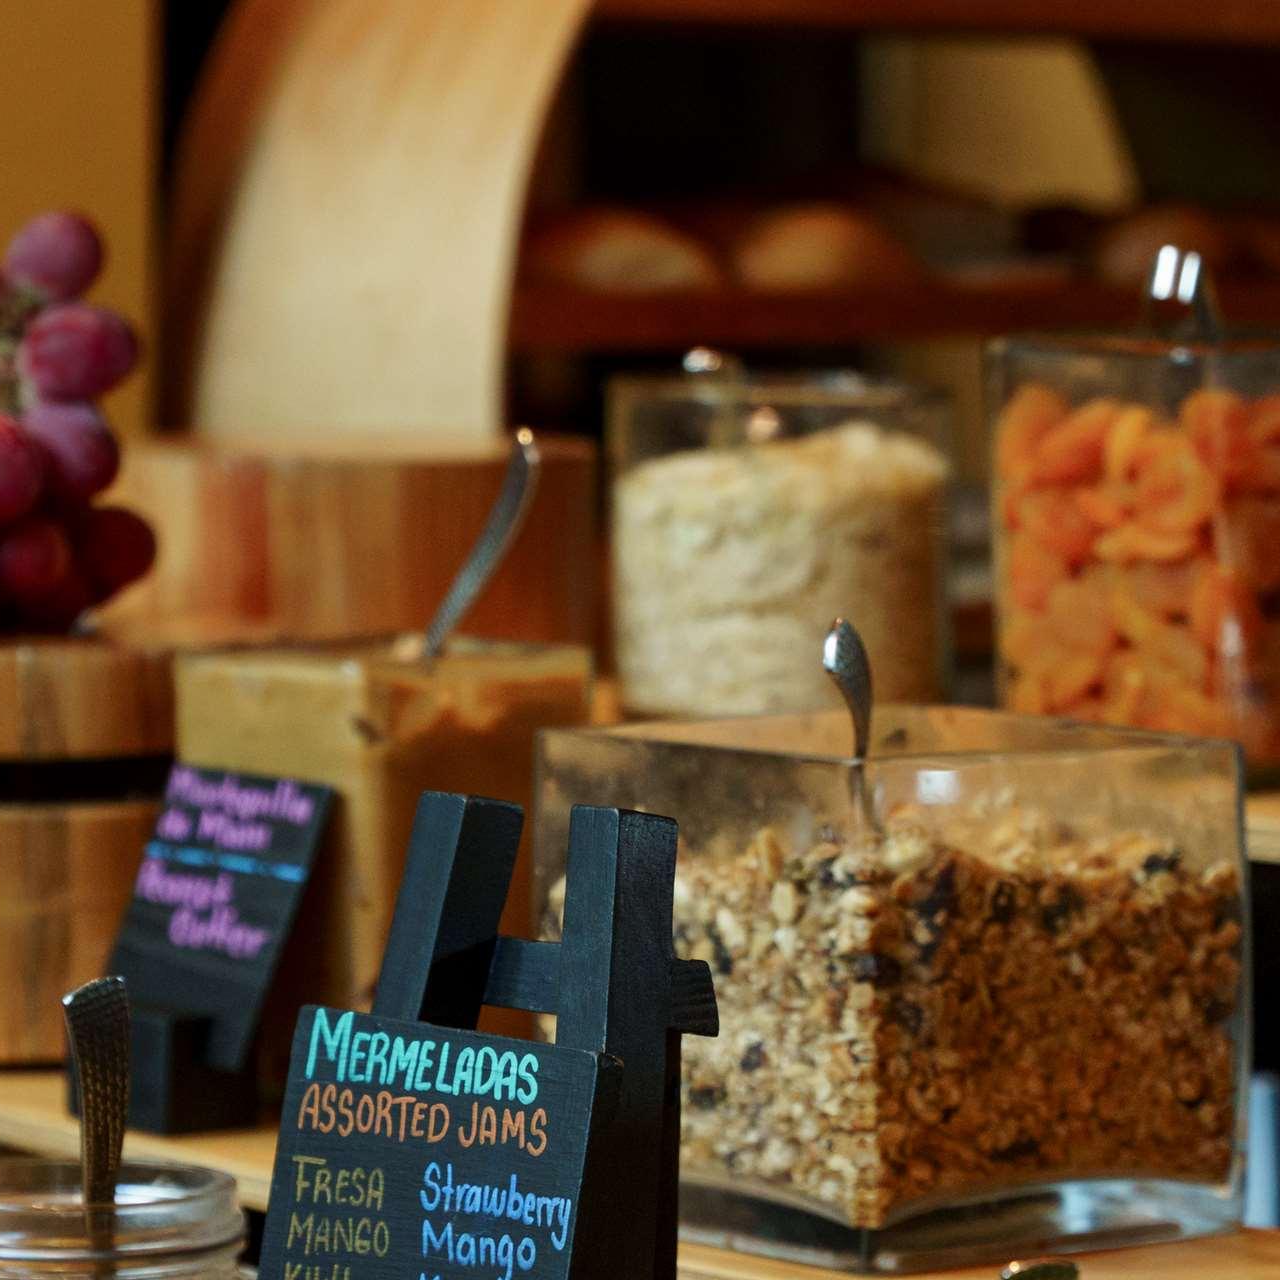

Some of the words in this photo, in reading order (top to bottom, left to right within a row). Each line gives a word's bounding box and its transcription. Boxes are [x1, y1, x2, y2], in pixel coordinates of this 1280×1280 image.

[304, 1008, 539, 1105] MERMELADAS
[297, 1083, 449, 1143] ASSORTED
[458, 1102, 548, 1157] JAMS
[292, 1155, 385, 1209] FRESA
[420, 1162, 572, 1251] Strawberry
[286, 1214, 389, 1257] MANGO
